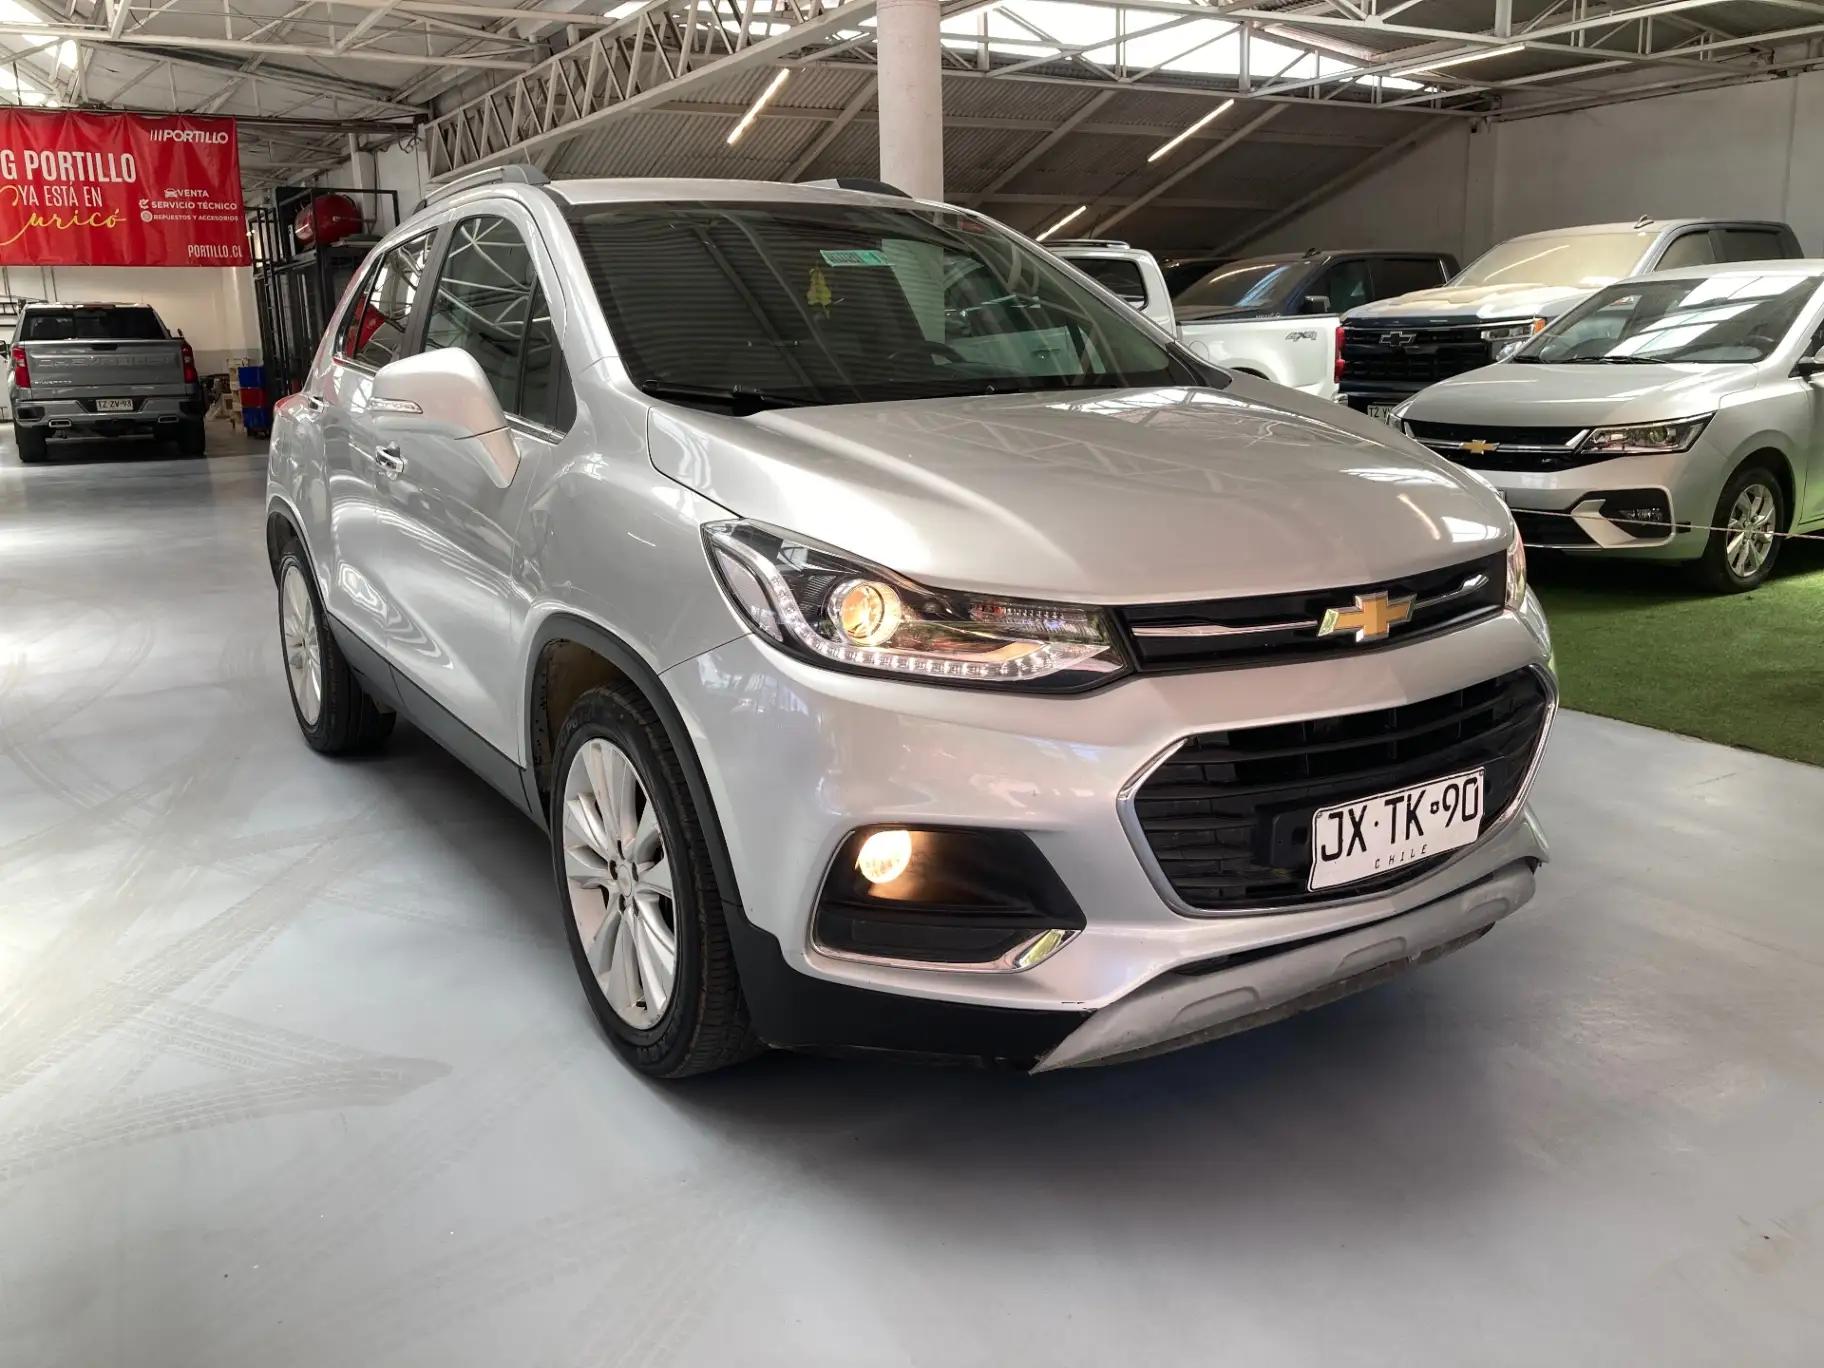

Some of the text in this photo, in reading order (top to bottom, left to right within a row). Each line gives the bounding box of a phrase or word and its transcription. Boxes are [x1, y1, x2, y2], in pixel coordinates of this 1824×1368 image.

[163, 129, 229, 144] PORTILLO
[0, 149, 137, 183] G PORTILLO
[18, 181, 103, 207] YA ESTÁ EN
[177, 189, 210, 198] VENTA
[151, 201, 237, 210] SERVICIO TÉCNICO
[187, 244, 243, 258] PORTILLO.CL
[1374, 843, 1428, 869] CHILE
